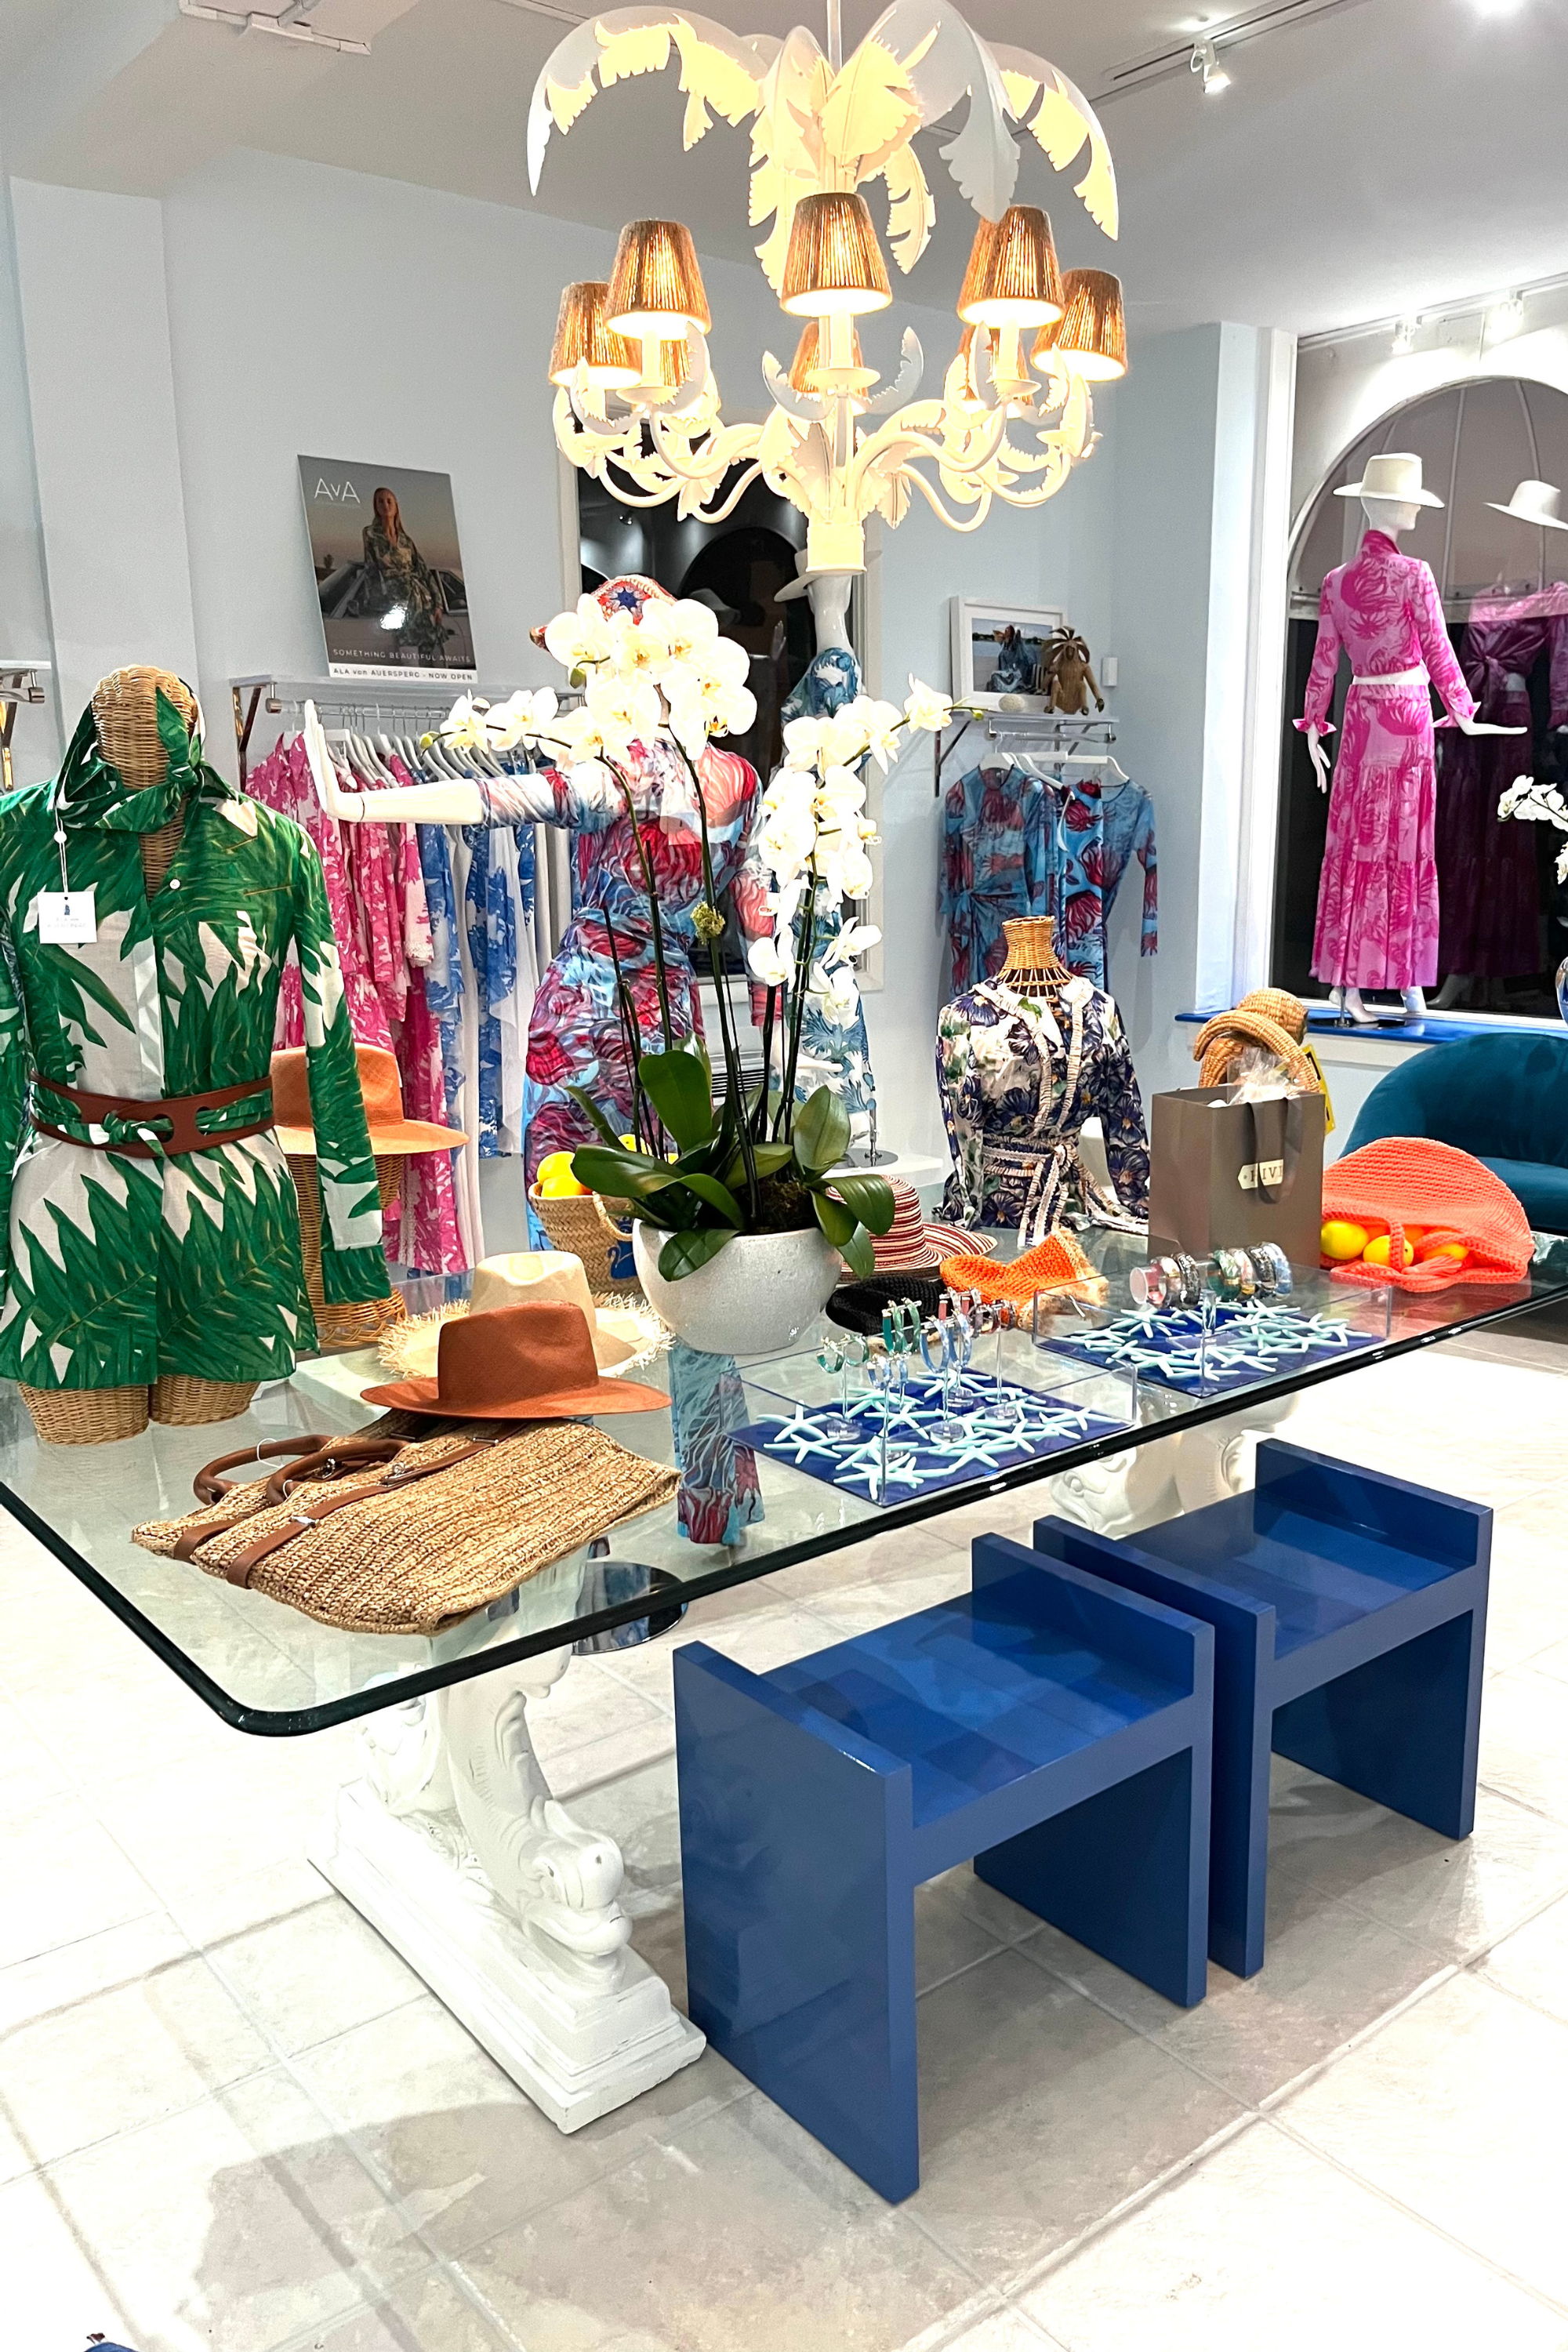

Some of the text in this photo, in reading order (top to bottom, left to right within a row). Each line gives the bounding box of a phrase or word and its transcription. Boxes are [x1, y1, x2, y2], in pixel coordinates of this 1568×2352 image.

[314, 477, 361, 503] AvA
[332, 648, 471, 663] SOMETHING BEAUTIFUL AWAITS
